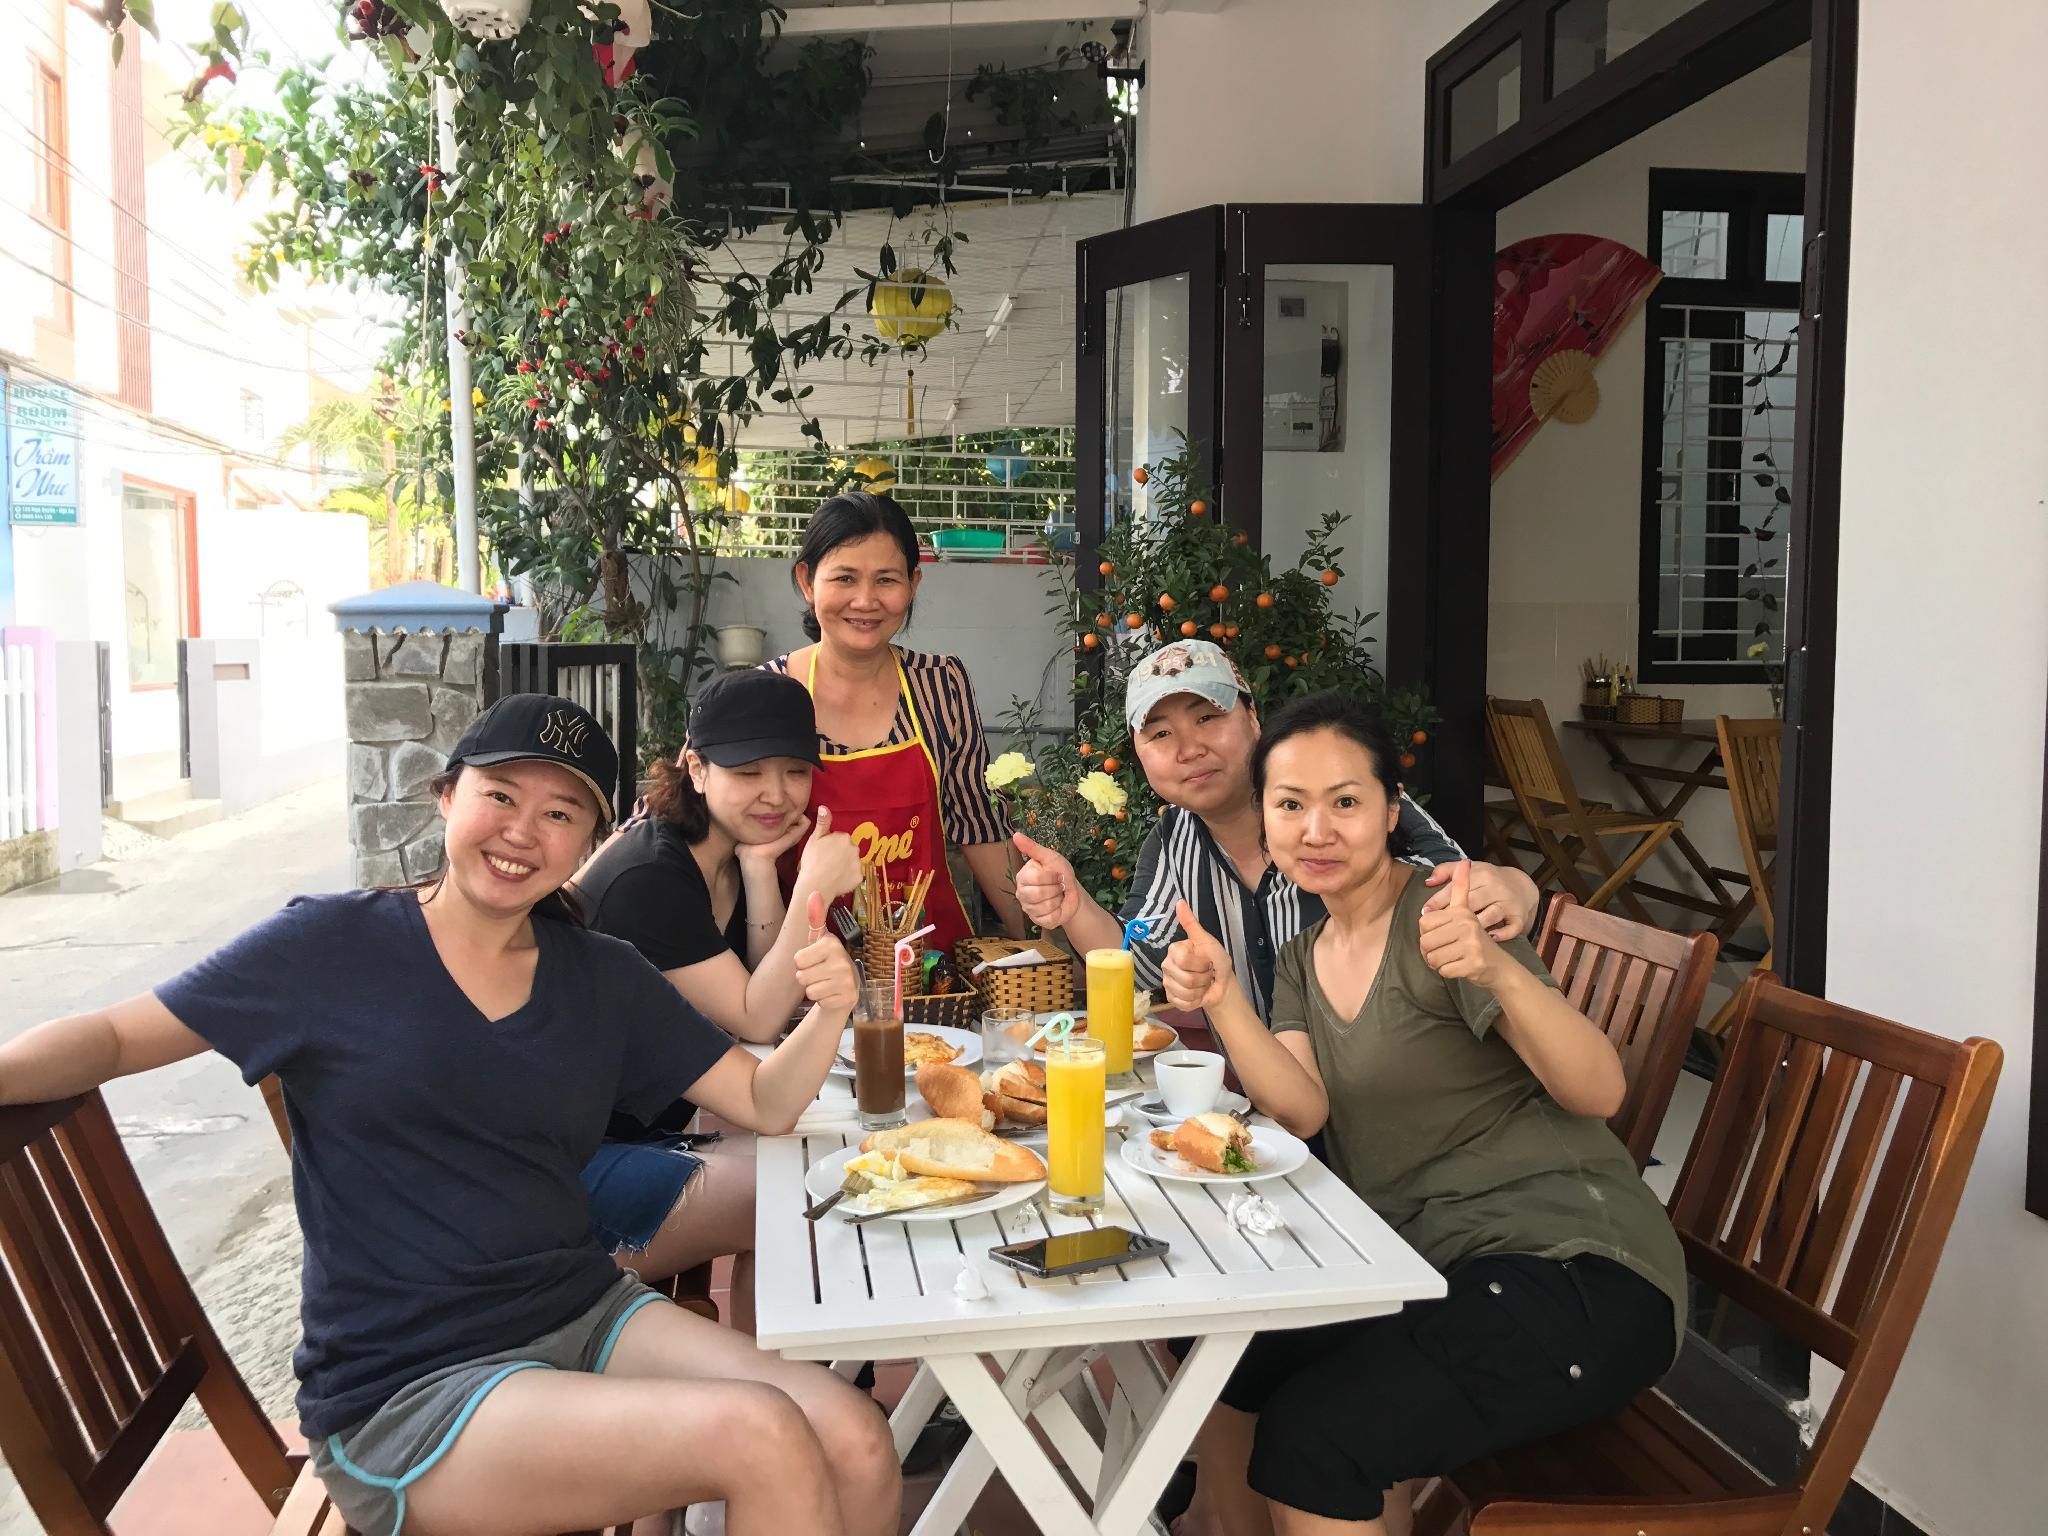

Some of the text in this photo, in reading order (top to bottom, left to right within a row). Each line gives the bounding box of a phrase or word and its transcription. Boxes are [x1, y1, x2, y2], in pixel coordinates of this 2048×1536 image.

[13, 387, 69, 400] HOUSE
[17, 406, 68, 418] ROOM
[540, 709, 590, 758] NY
